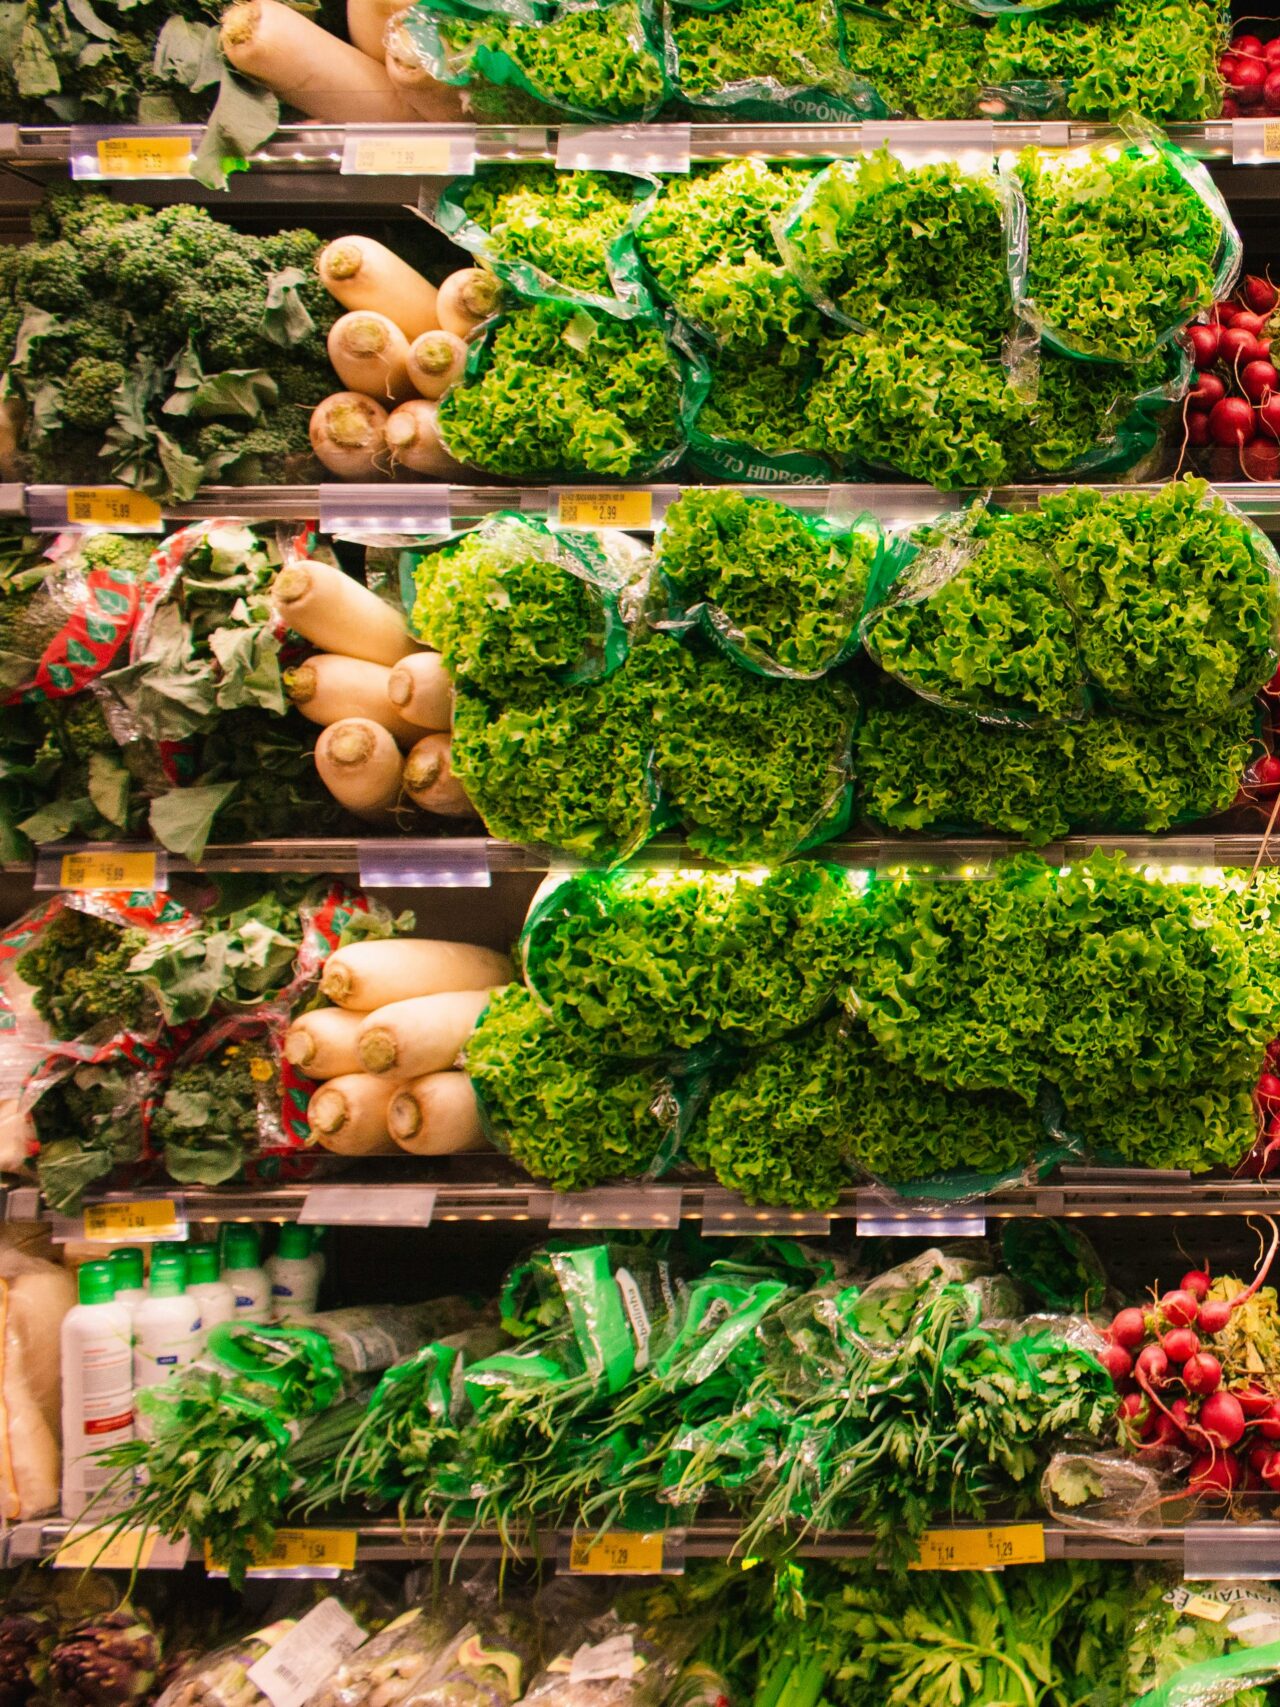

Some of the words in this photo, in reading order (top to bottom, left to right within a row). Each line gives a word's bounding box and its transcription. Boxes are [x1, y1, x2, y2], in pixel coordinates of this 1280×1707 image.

[599, 506, 617, 520] 2,99
[627, 1287, 648, 1338] bolinha
[611, 1549, 628, 1565] 1,29
[996, 1541, 1013, 1558] 1,29
